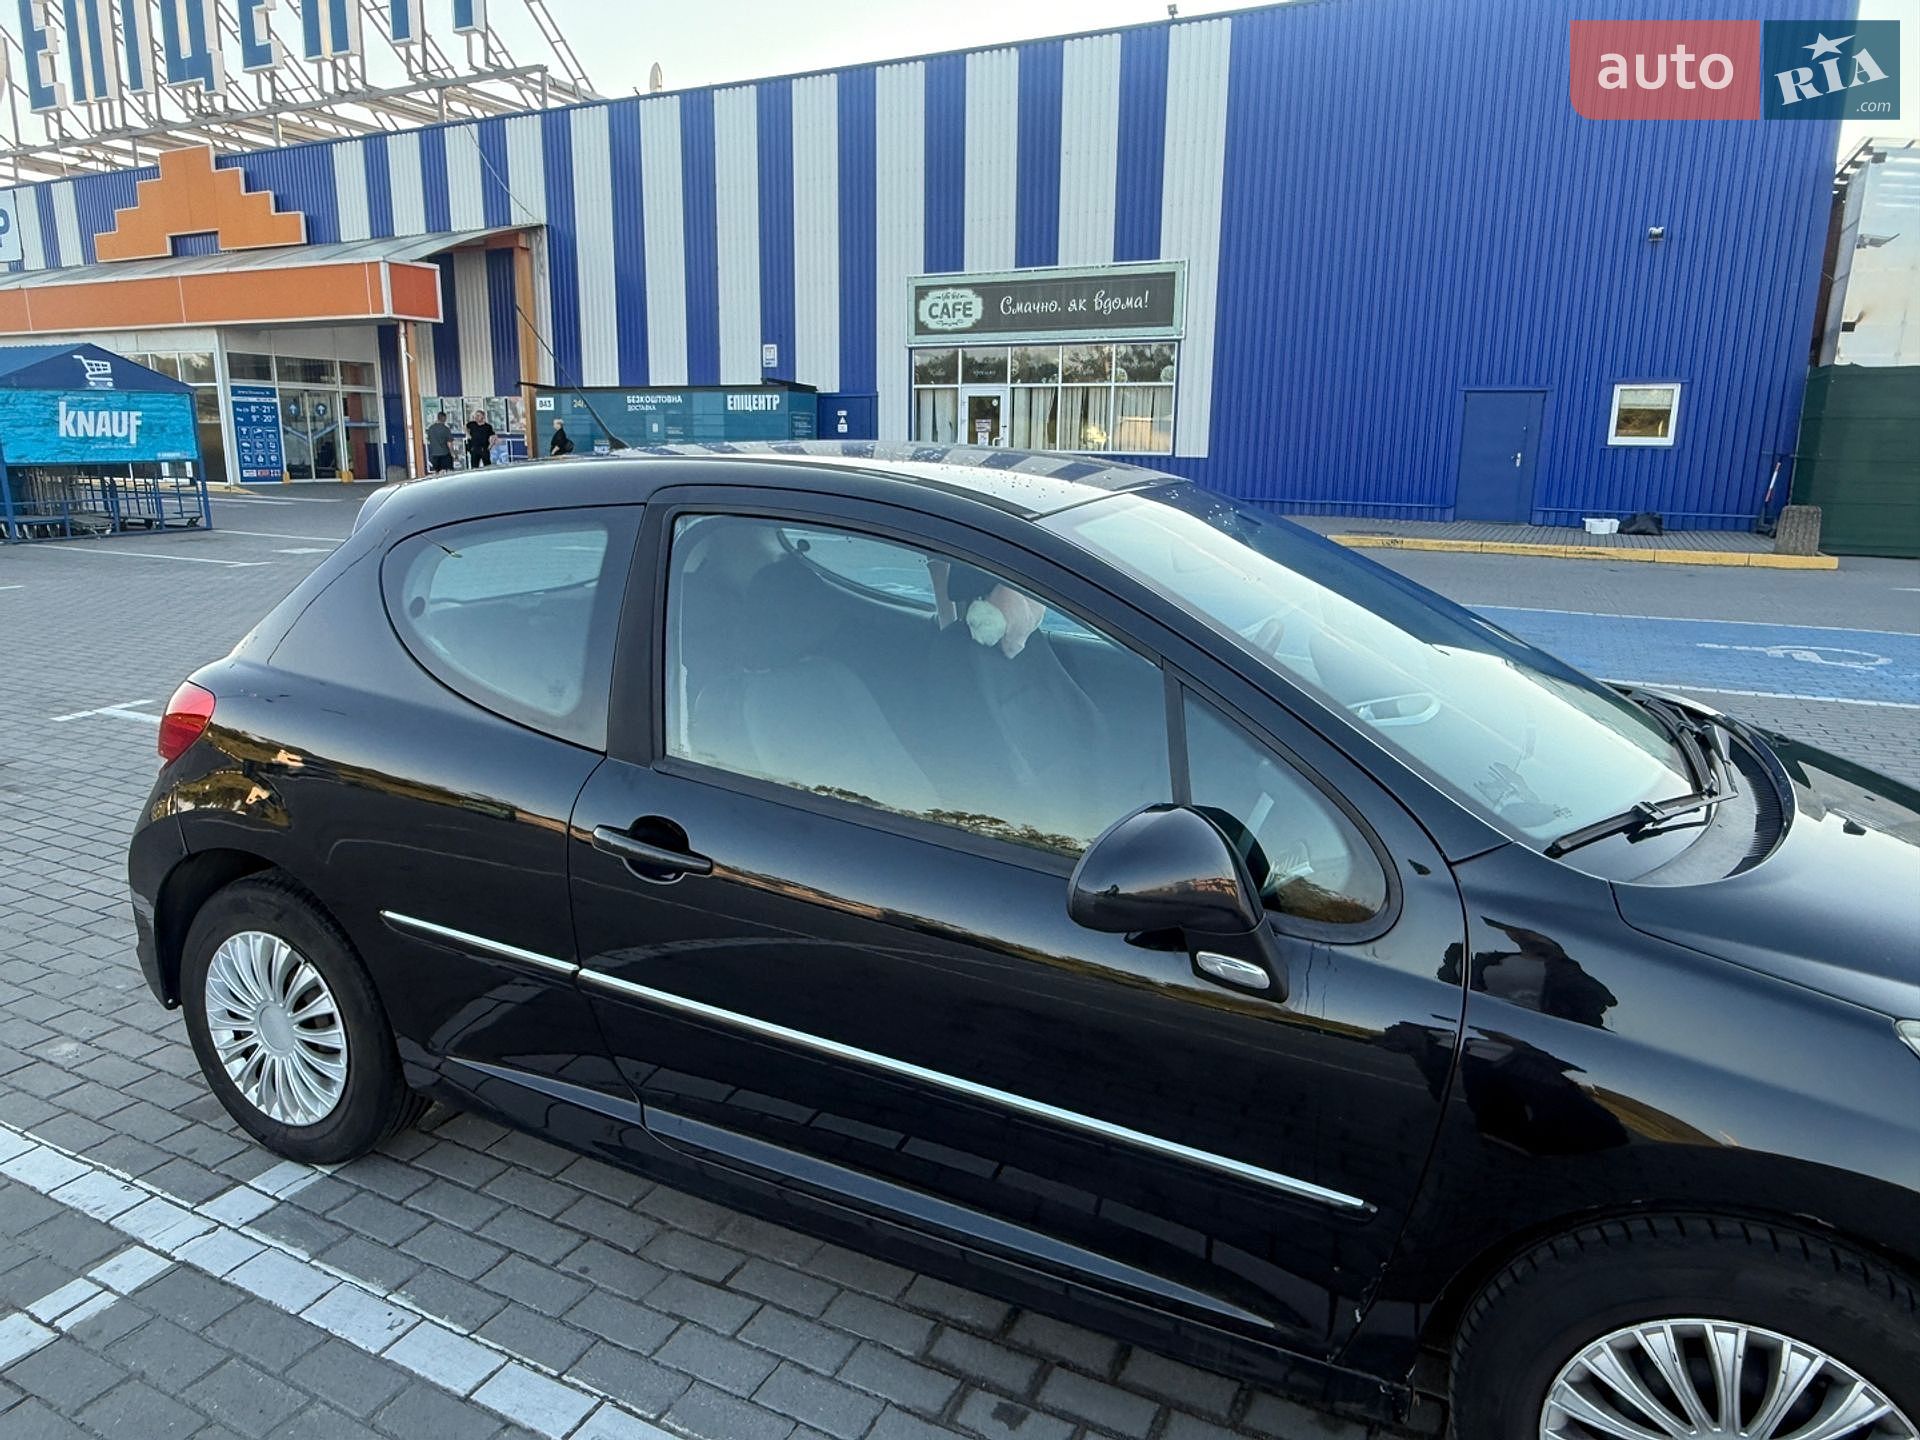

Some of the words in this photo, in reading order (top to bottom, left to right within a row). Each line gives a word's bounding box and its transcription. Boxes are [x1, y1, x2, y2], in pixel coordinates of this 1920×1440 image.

[928, 301, 973, 319] CAFE
[1067, 298, 1087, 312] як
[1094, 289, 1149, 315] вдома!
[727, 394, 780, 412] ЕПІЦЕНТР
[59, 401, 142, 444] KNAUF
